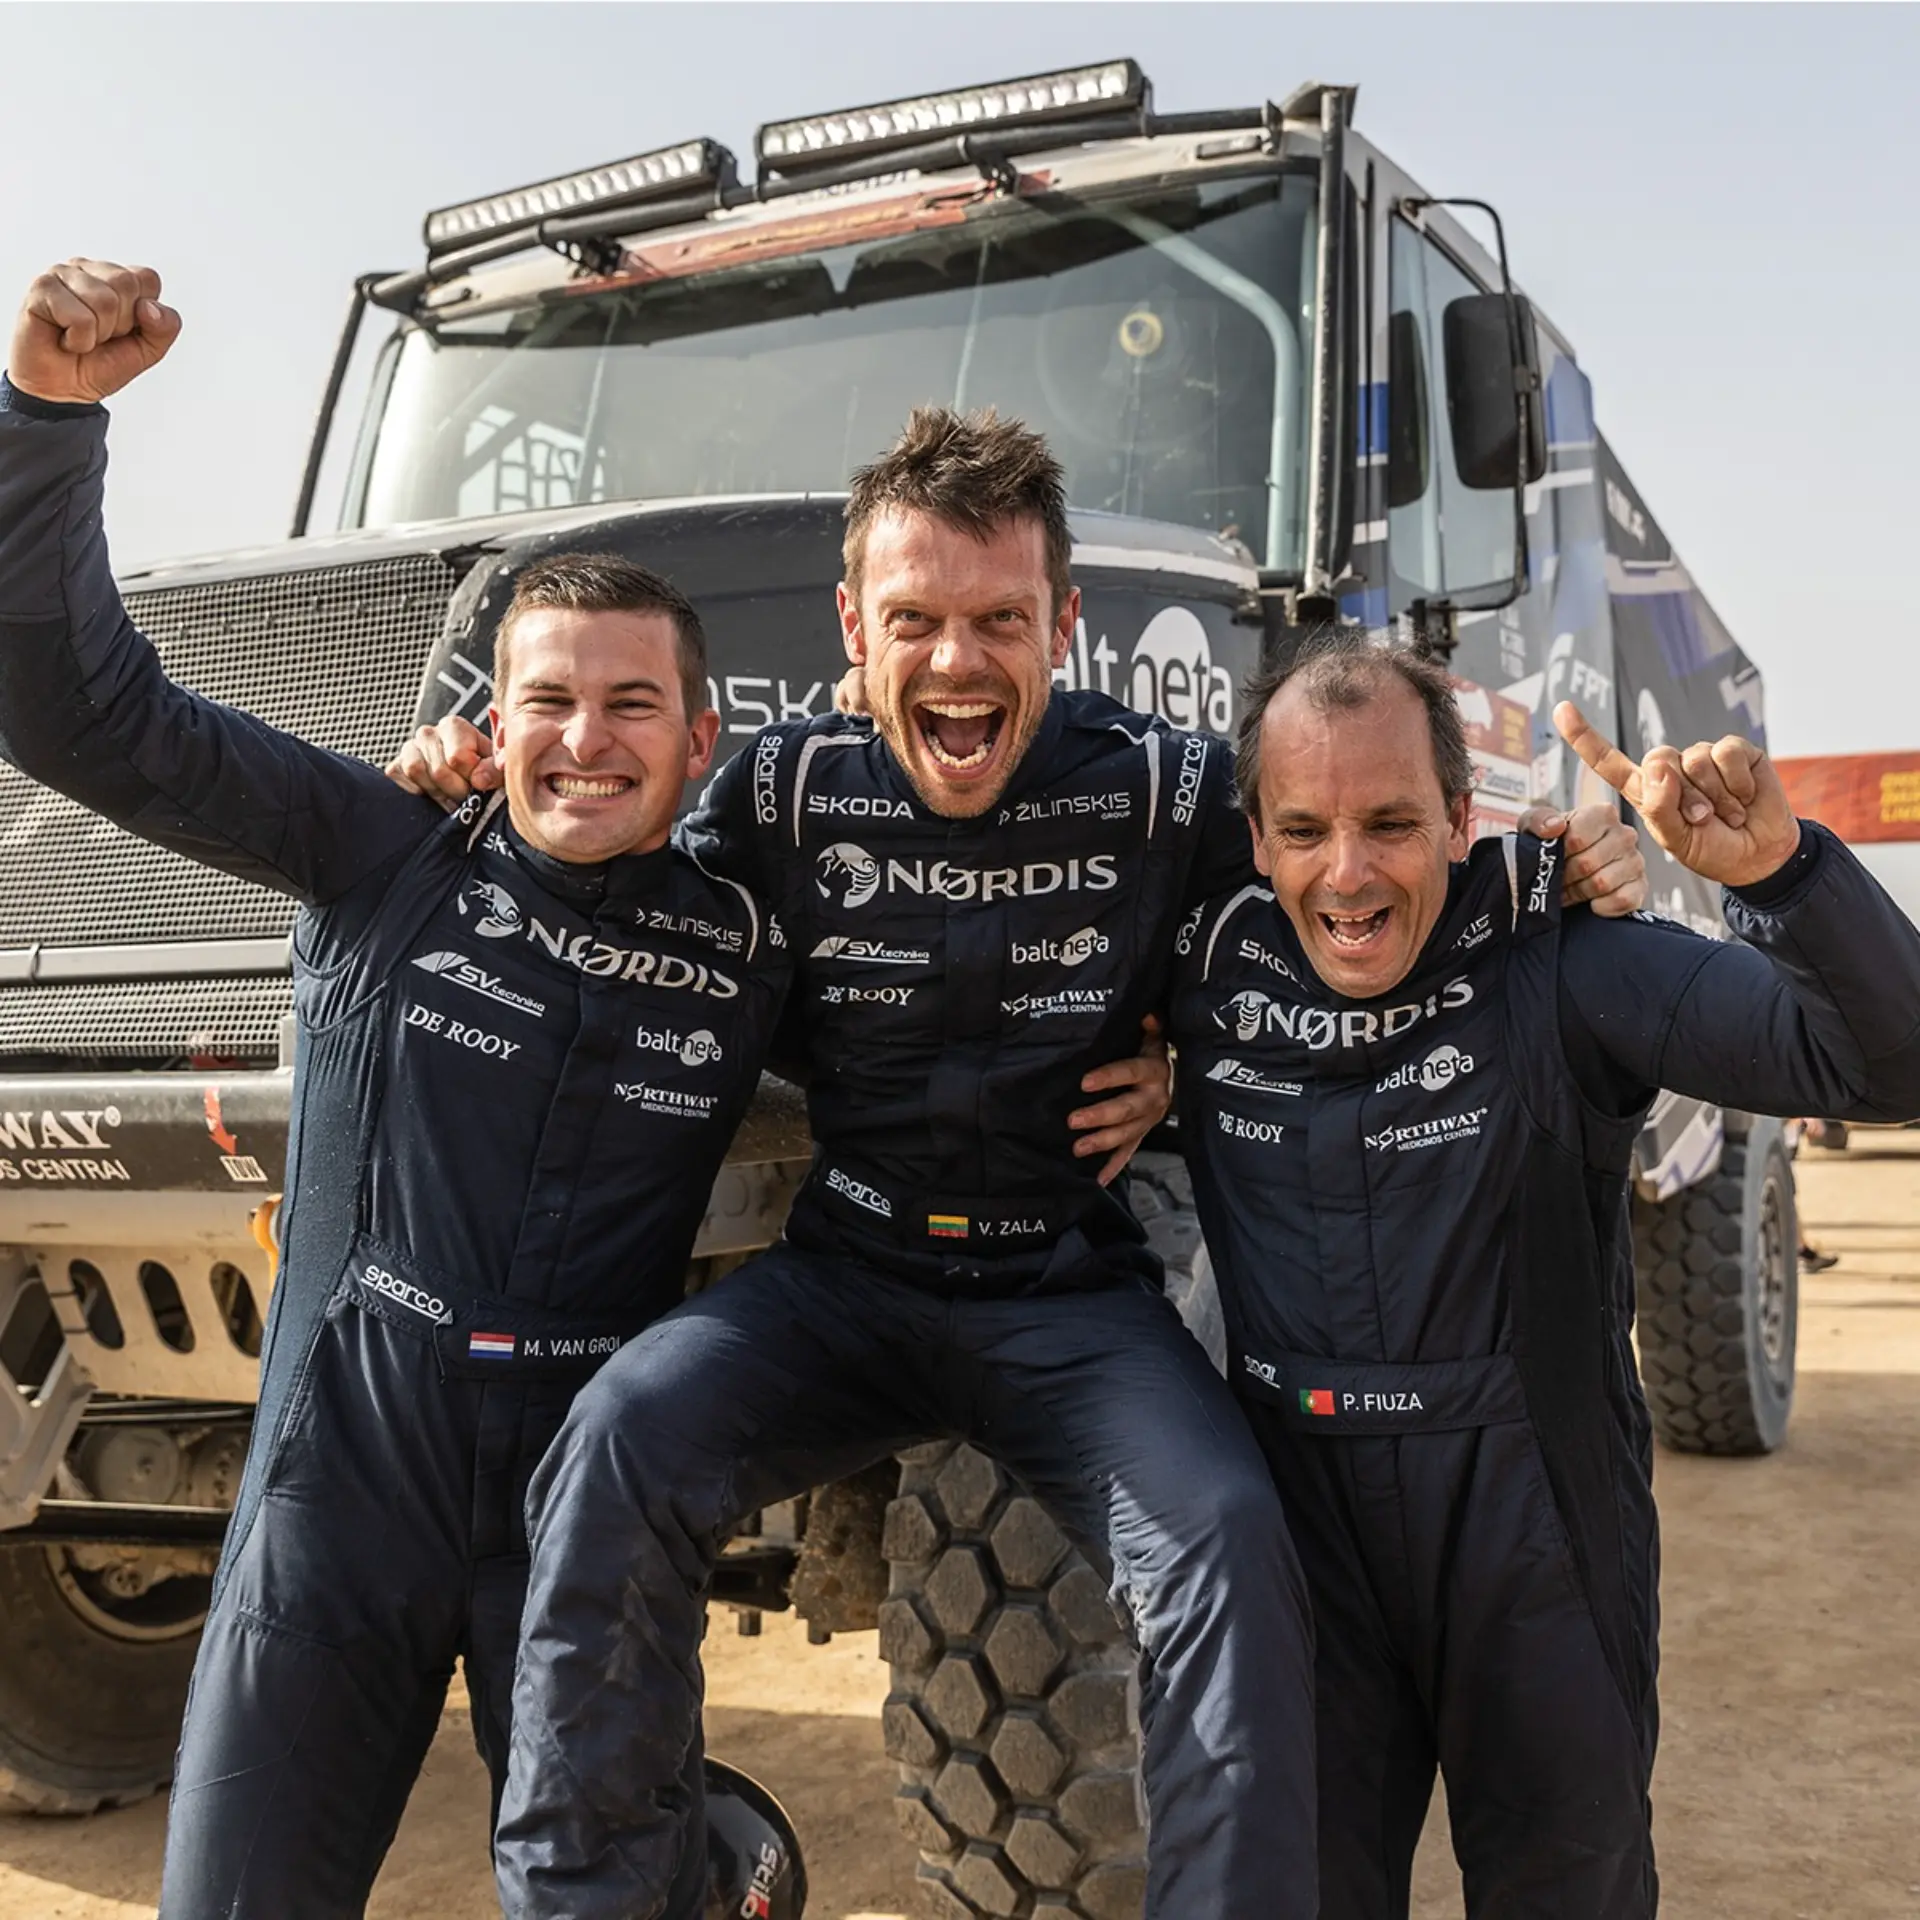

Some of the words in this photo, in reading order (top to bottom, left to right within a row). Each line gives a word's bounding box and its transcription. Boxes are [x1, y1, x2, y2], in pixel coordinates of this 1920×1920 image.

[1052, 606, 1232, 733] altneta
[1569, 656, 1613, 712] FPT
[754, 735, 783, 824] sparco
[1172, 738, 1208, 826] sparco
[848, 986, 914, 1006] ROOY
[404, 1003, 446, 1033] DE
[443, 1020, 521, 1061] ROOY
[1235, 1118, 1284, 1143] ROOY
[826, 1167, 892, 1218] sparco
[978, 1221, 994, 1236] V.
[1000, 1219, 1046, 1236] ZALA
[360, 1264, 444, 1321] sparco
[523, 1339, 545, 1357] M.
[550, 1338, 585, 1357] VAN
[1342, 1393, 1360, 1411] P.
[1364, 1392, 1423, 1412] FIUZA
